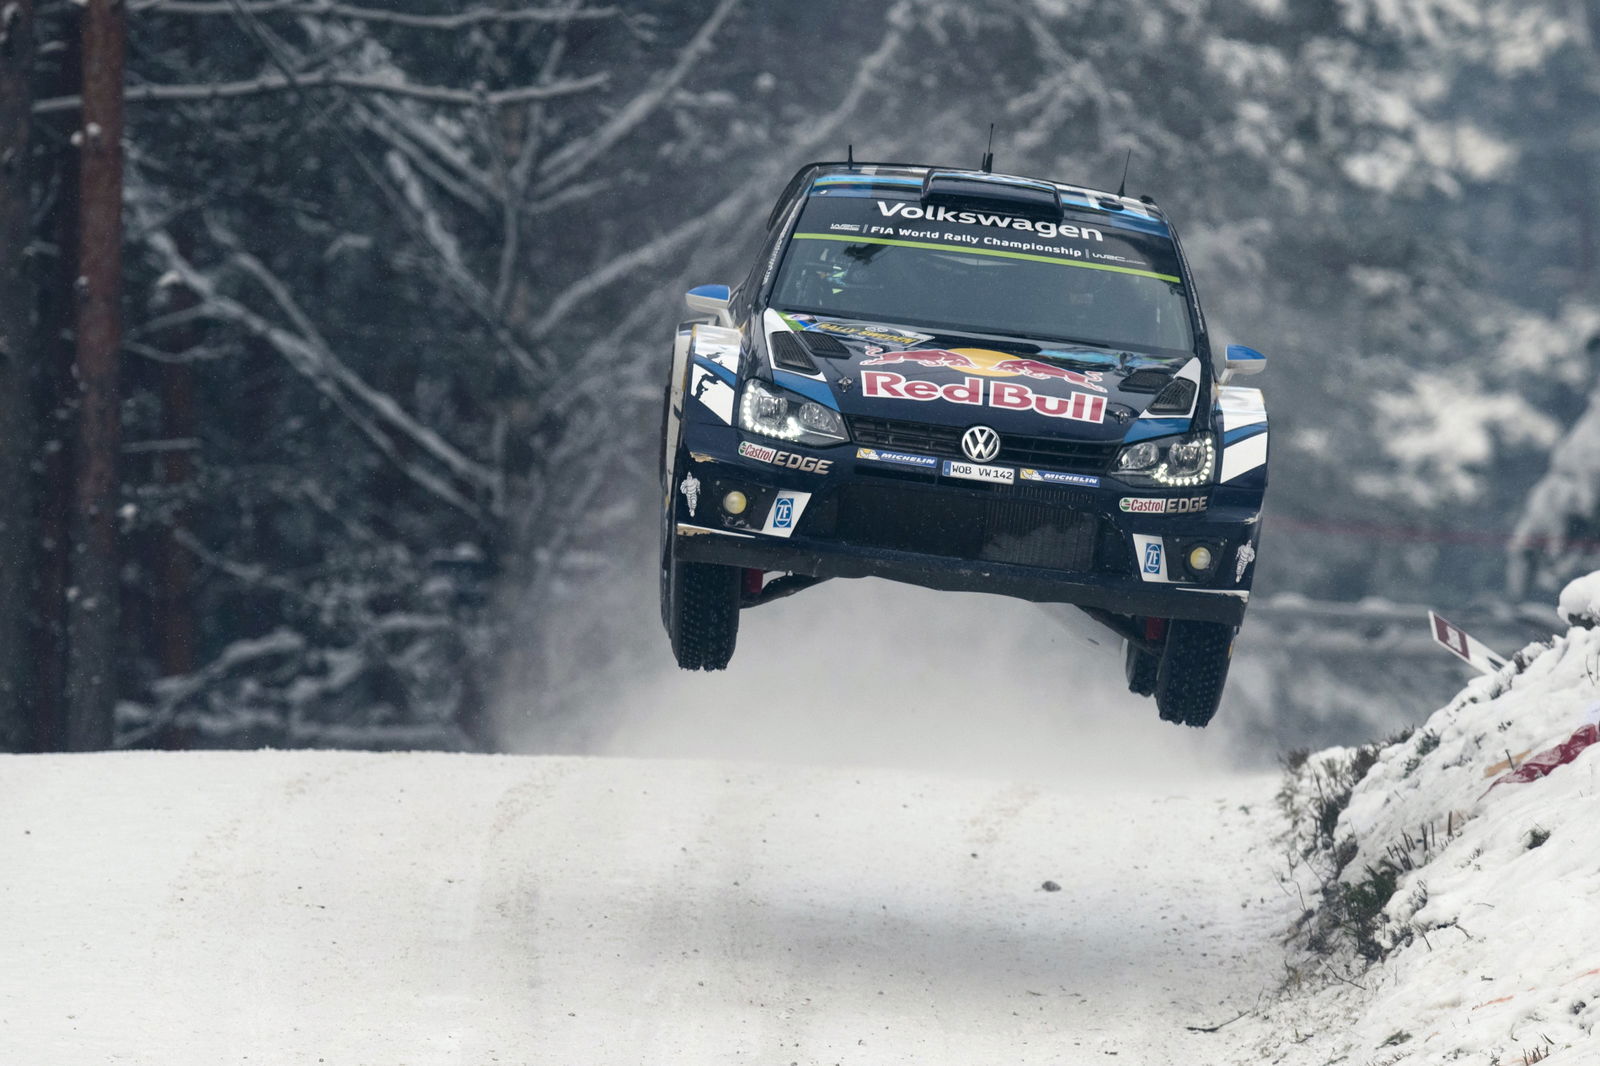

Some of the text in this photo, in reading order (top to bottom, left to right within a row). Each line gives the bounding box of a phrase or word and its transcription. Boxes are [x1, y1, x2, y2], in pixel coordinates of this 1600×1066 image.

[877, 201, 1104, 241] Volkswagen
[871, 226, 894, 235] FIA
[898, 228, 939, 239] World
[944, 232, 979, 244] Rally
[983, 237, 1082, 257] Championship
[860, 370, 1108, 424] Red Bull
[744, 444, 834, 475] Castrol EDGE
[880, 453, 935, 465] MICHELIN
[952, 465, 1013, 480] WOB VW 142
[1043, 473, 1098, 484] MICHELIN
[776, 504, 791, 521] ZF
[1130, 496, 1208, 513] Castrol EDGE
[1146, 550, 1160, 566] ZF
